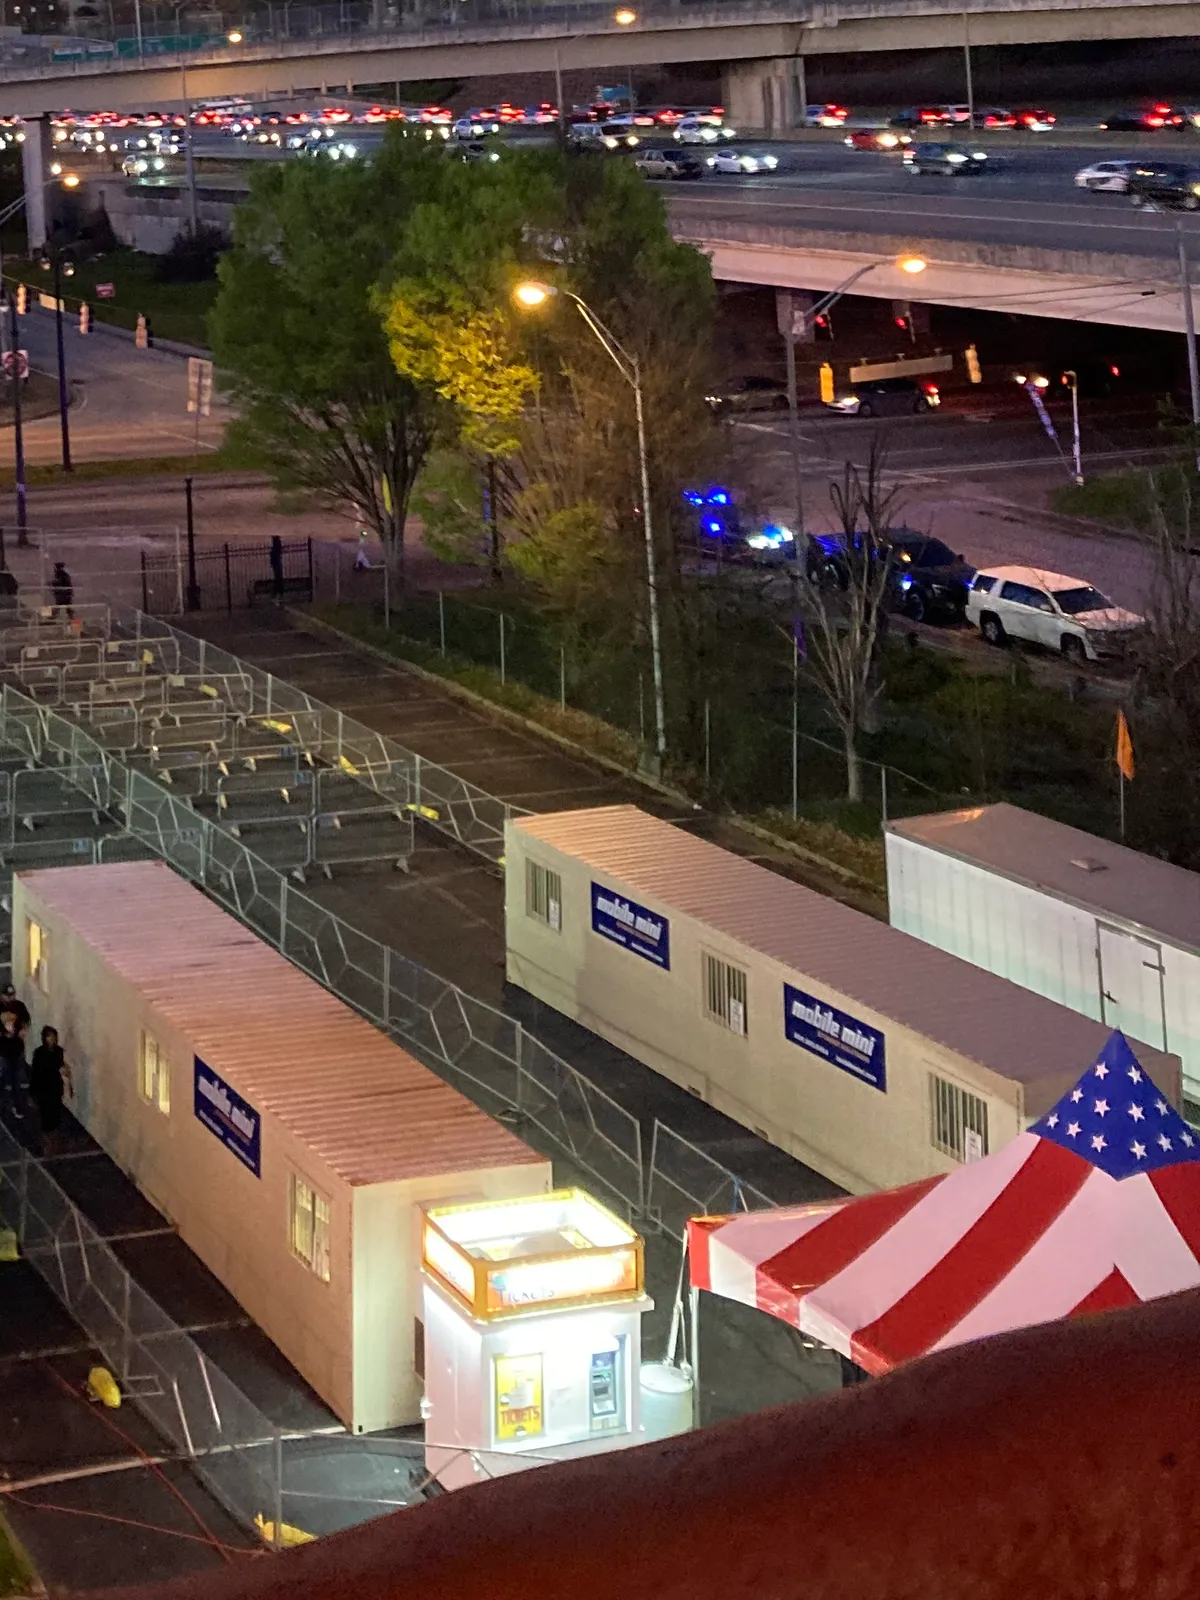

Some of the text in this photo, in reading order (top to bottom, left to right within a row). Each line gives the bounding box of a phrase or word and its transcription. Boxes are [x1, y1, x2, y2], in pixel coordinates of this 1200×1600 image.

[597, 897, 635, 927] mobile
[635, 915, 662, 940] mini
[792, 1000, 840, 1038] mobile
[841, 1025, 876, 1056] mini
[198, 1075, 232, 1117] mobile
[231, 1105, 256, 1139] mini
[501, 1407, 540, 1426] TICKETS
